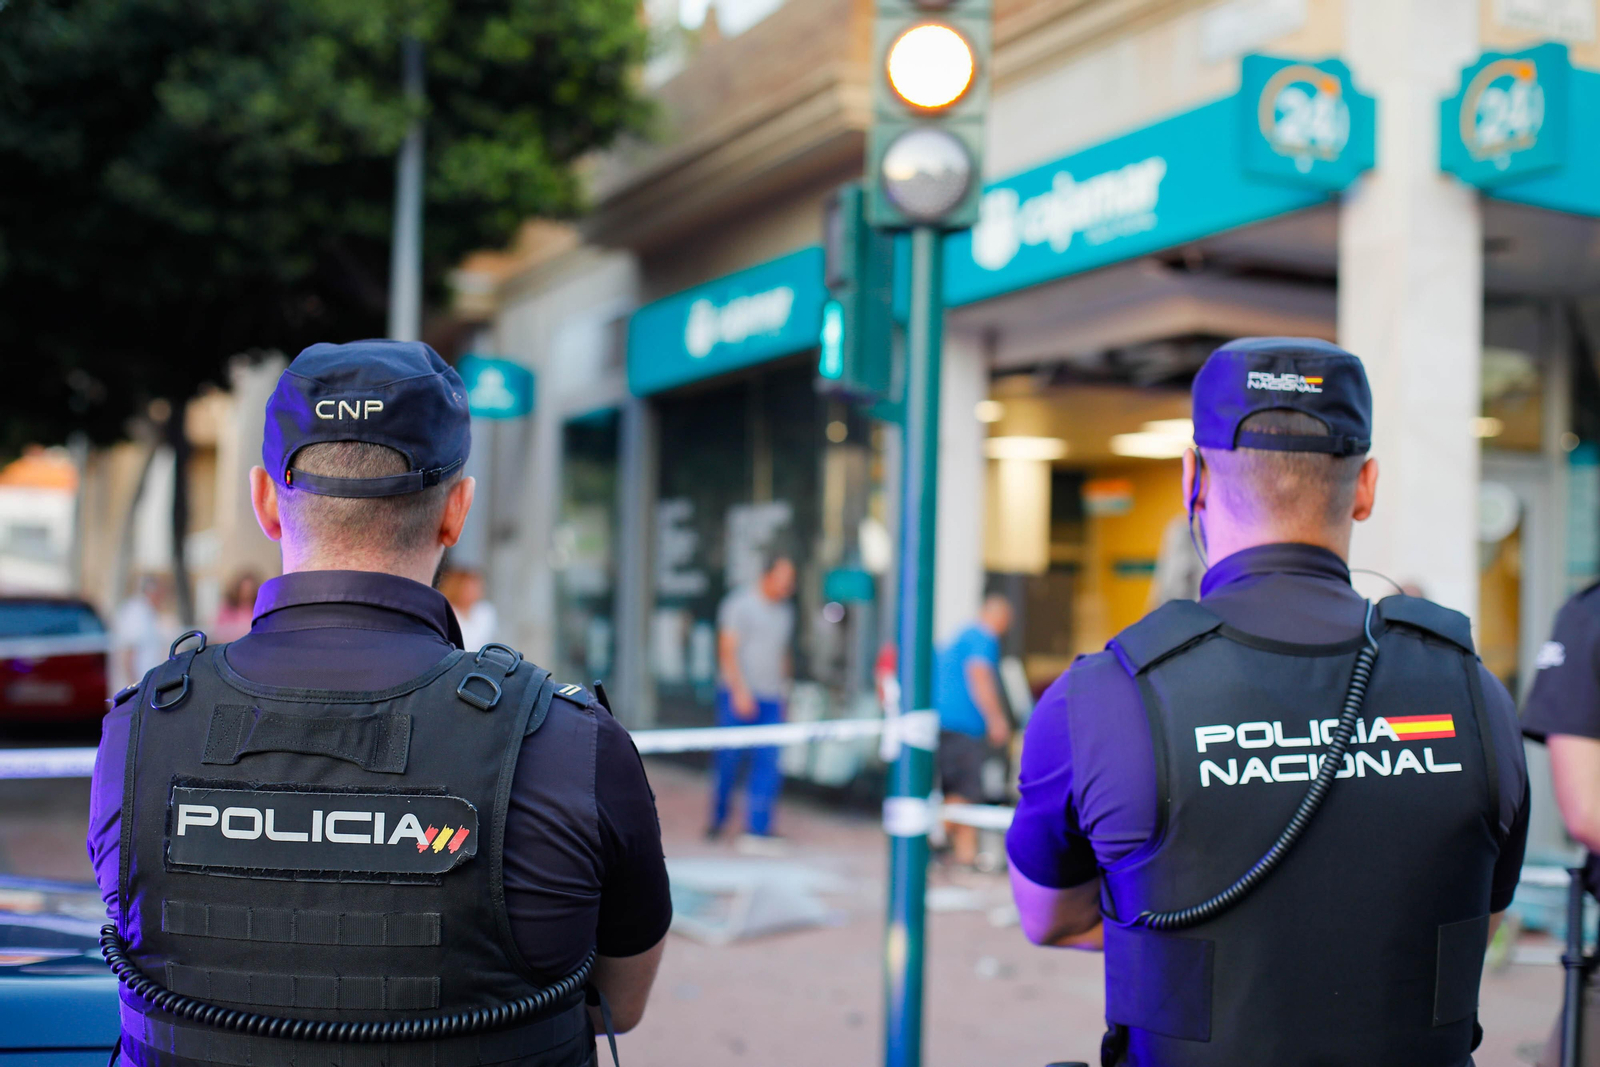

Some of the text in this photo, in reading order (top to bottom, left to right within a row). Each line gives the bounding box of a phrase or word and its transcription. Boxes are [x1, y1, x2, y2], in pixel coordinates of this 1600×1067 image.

[1246, 379, 1323, 393] NACIONAL
[315, 400, 384, 420] CNP
[1199, 747, 1462, 787] NACIONAL
[177, 804, 429, 845] POLICIA
